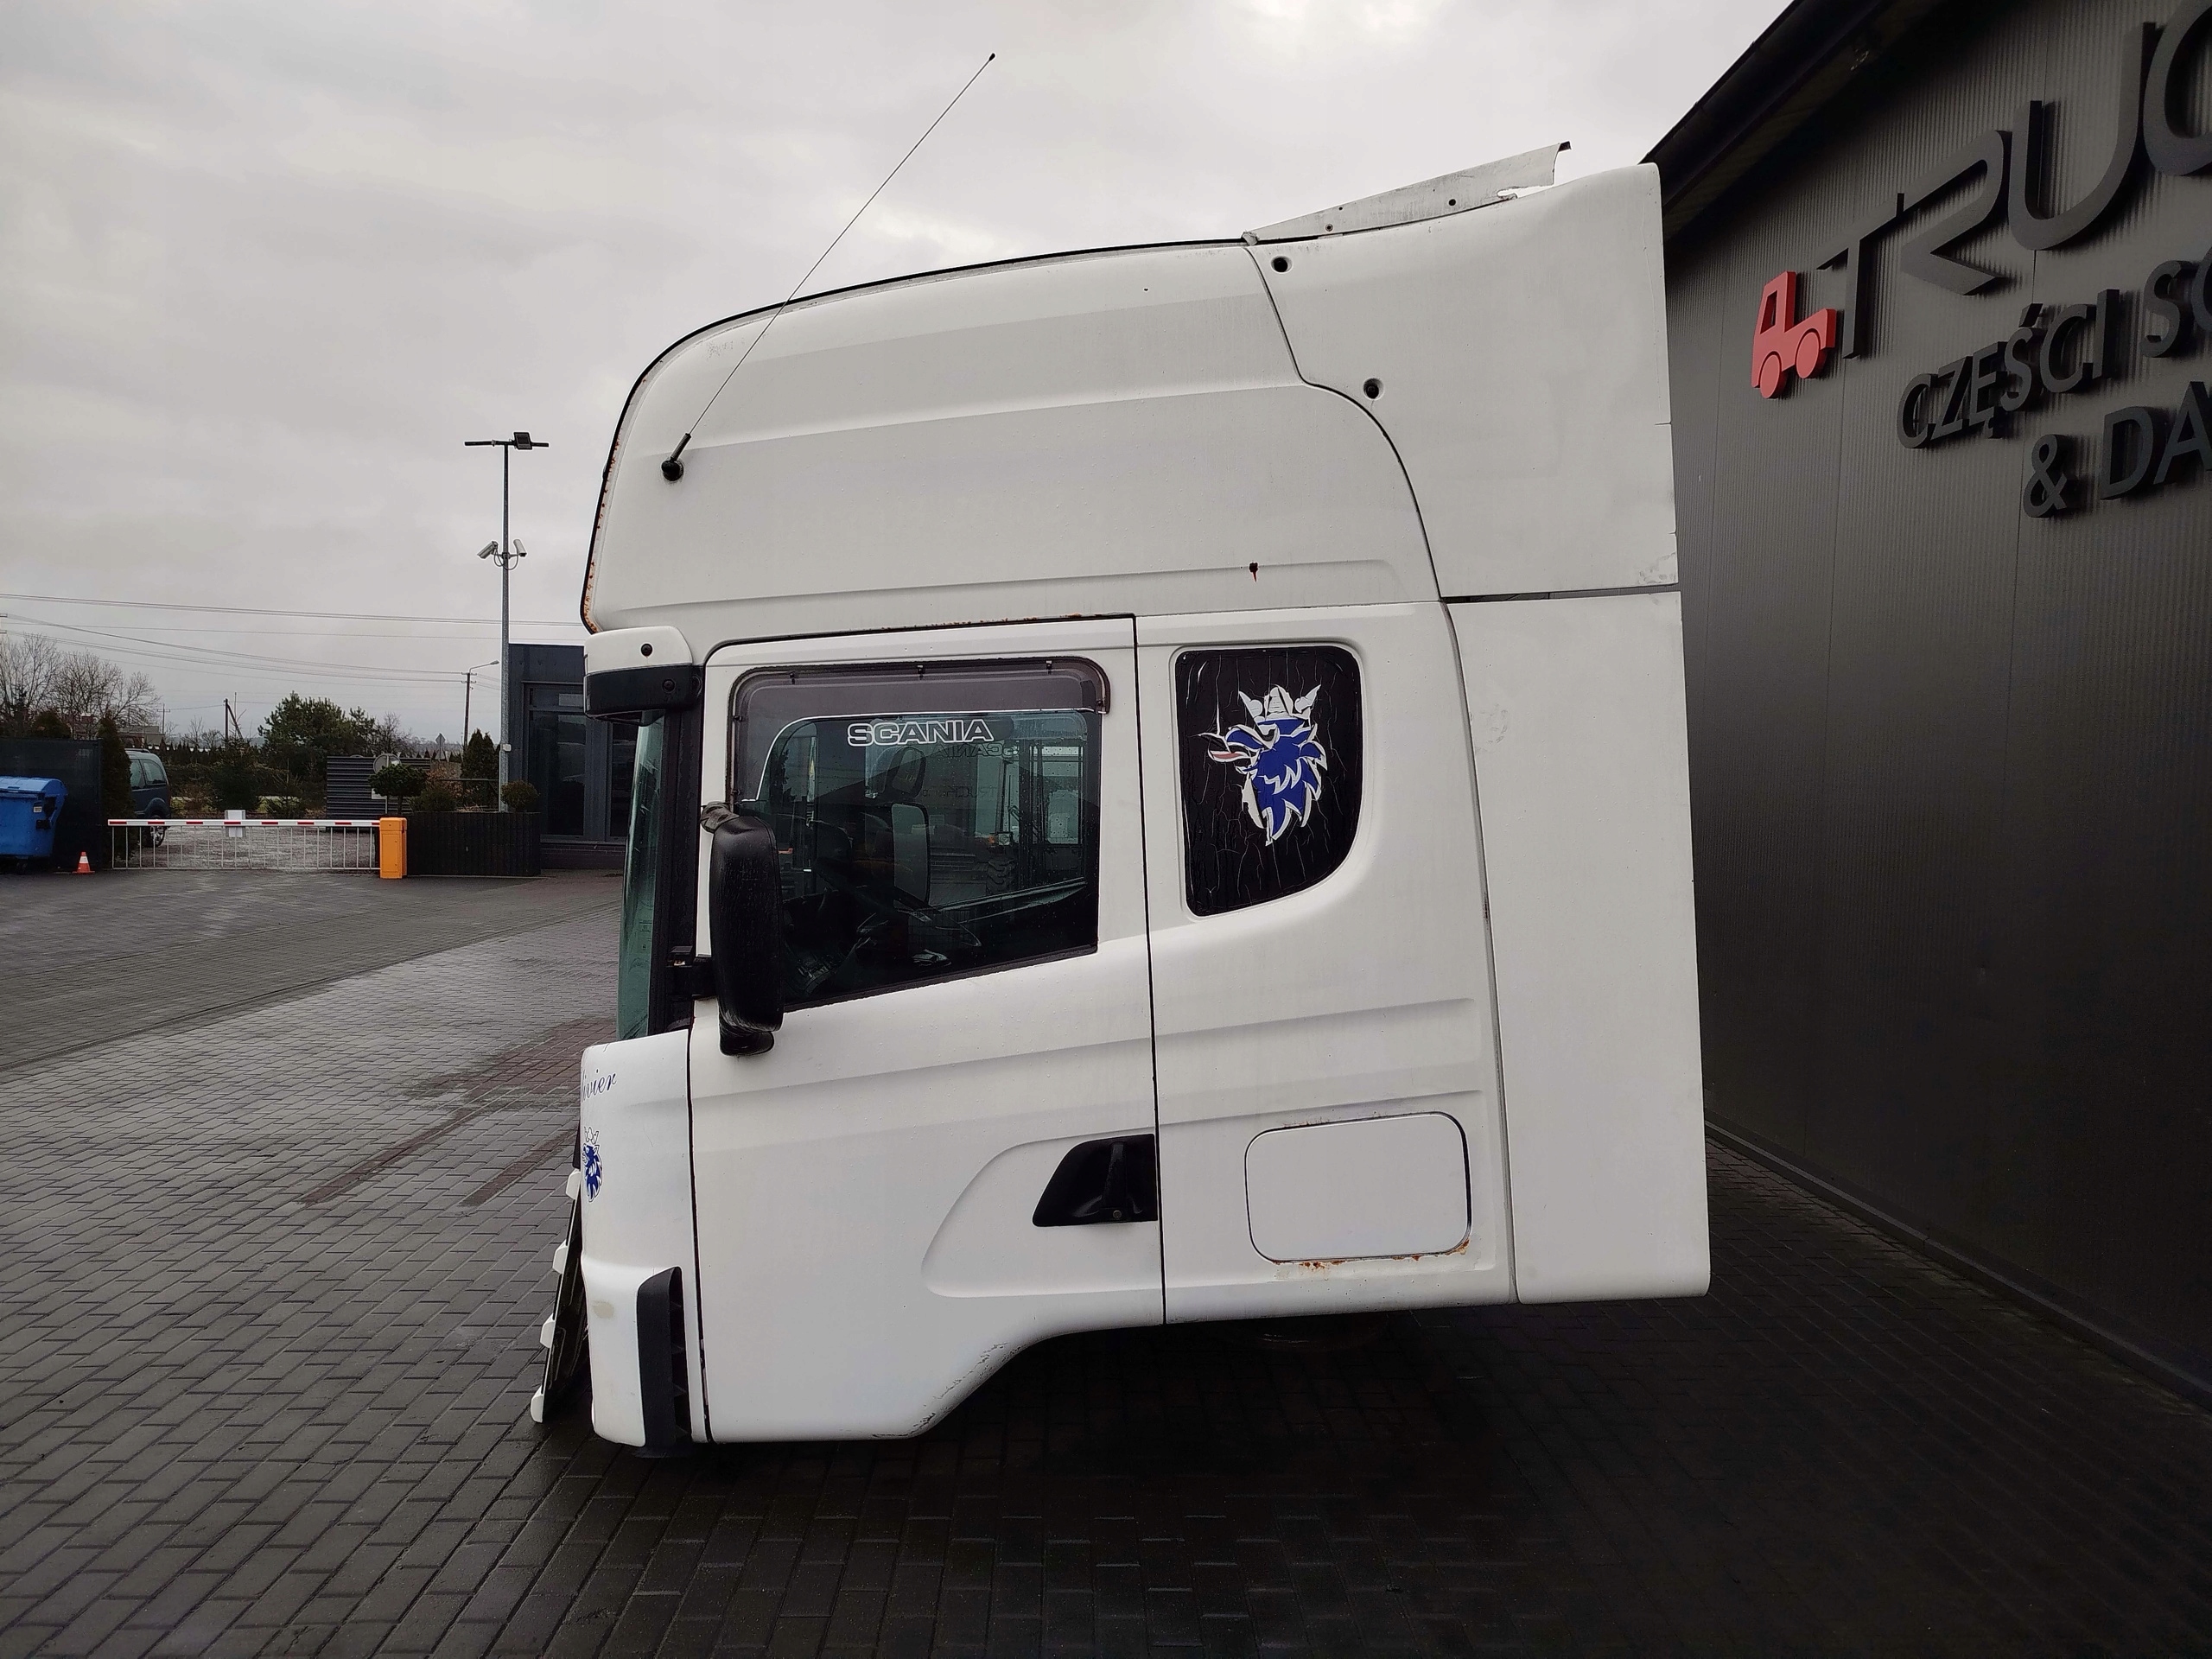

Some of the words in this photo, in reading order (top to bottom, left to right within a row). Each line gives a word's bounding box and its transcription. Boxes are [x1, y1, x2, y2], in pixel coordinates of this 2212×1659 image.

[1897, 289, 2120, 449] CZĘŚCI
[2140, 245, 2212, 359] S
[2023, 434, 2074, 518] &
[847, 718, 995, 747] SCANIA
